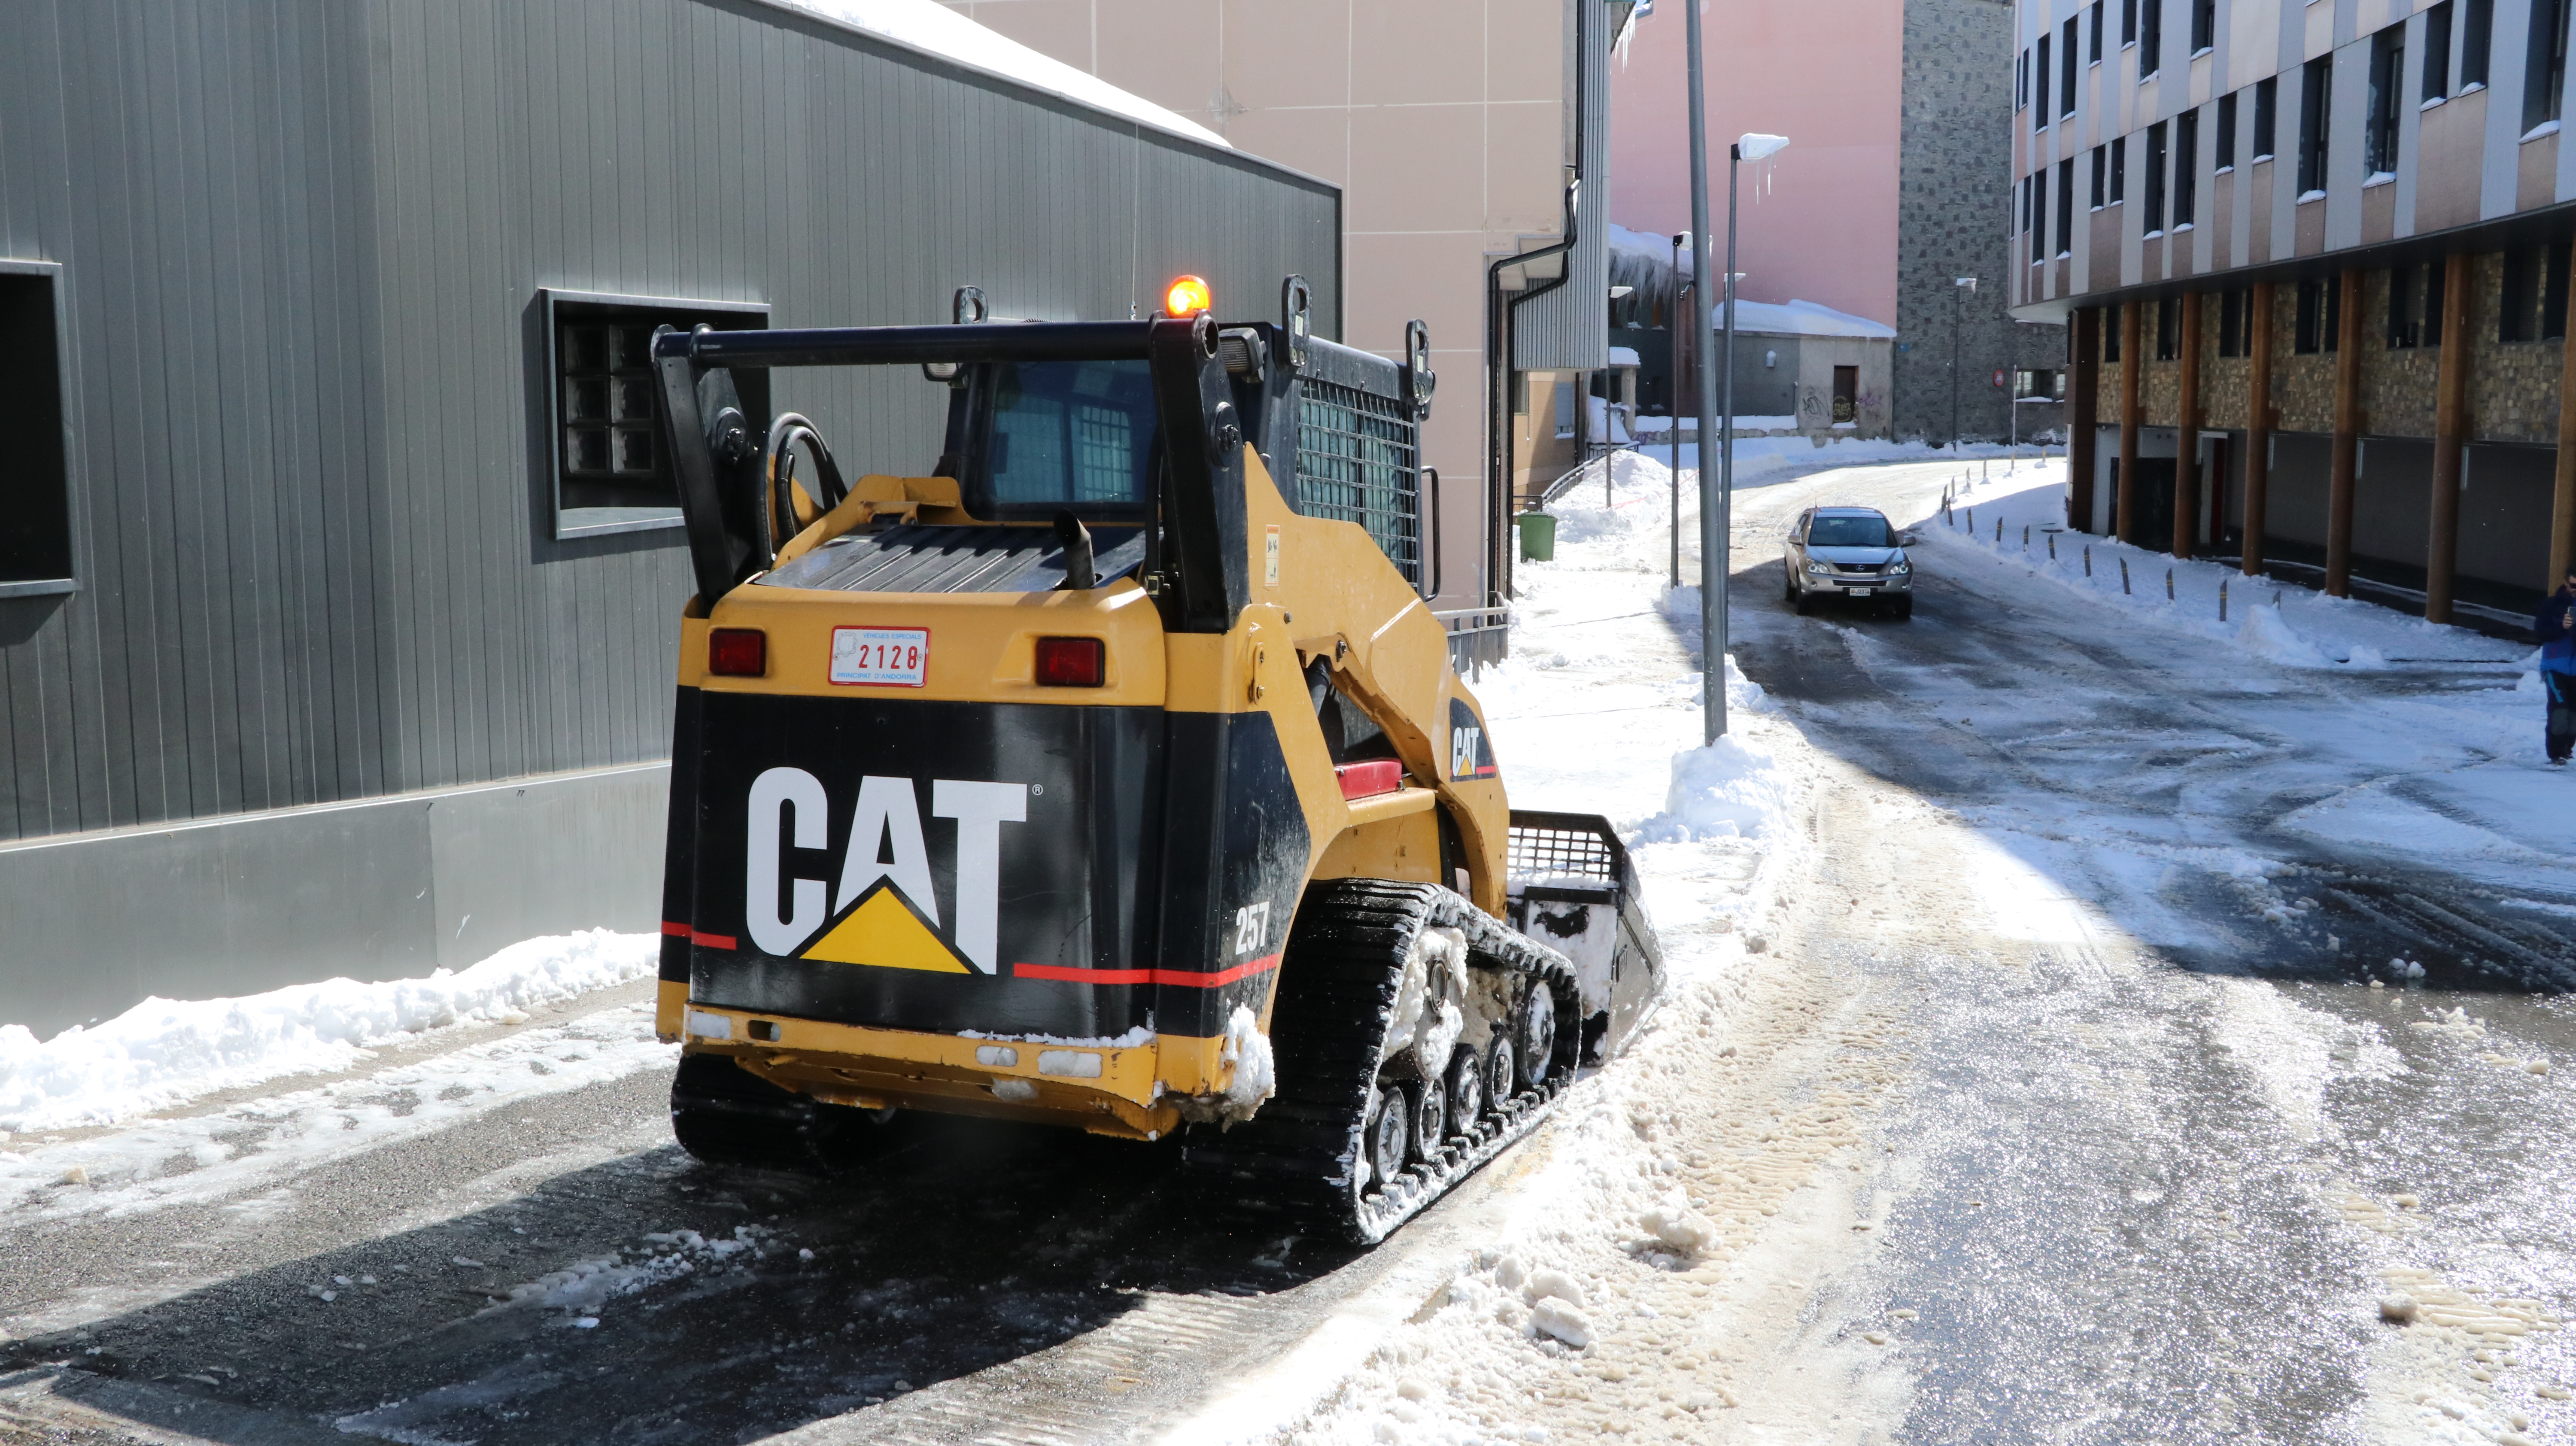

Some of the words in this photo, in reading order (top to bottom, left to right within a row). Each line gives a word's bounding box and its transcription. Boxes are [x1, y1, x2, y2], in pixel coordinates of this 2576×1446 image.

[859, 644, 918, 670] 2128
[1452, 726, 1480, 777] CAT
[746, 766, 1027, 975] CAT
[1235, 901, 1270, 955] 257
